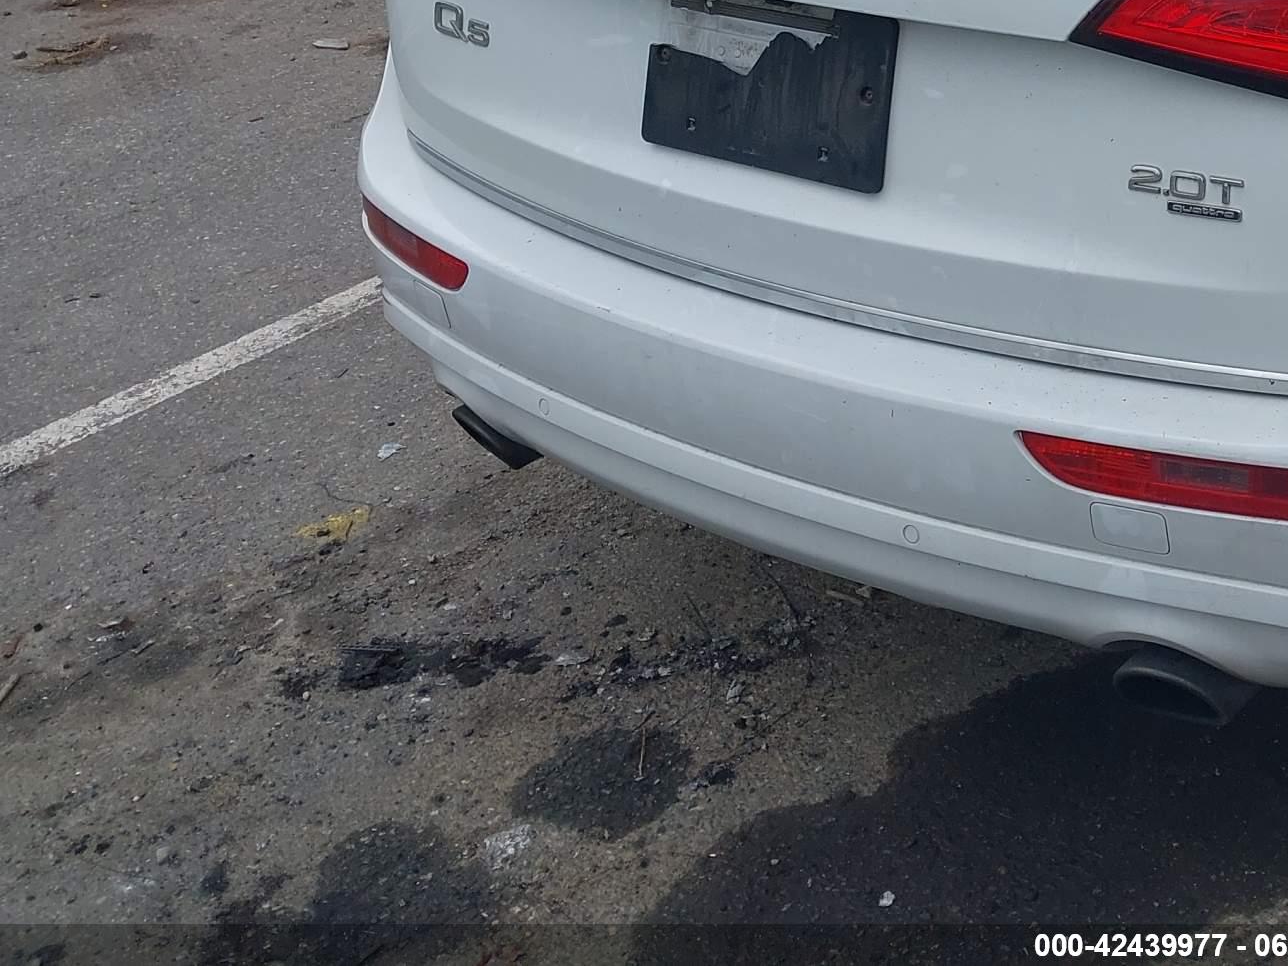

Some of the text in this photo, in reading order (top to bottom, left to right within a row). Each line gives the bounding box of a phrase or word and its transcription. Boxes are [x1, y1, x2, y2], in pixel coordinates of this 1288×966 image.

[433, 0, 490, 48] Q5
[1127, 163, 1245, 205] 2.0T
[1170, 202, 1237, 220] quattro
